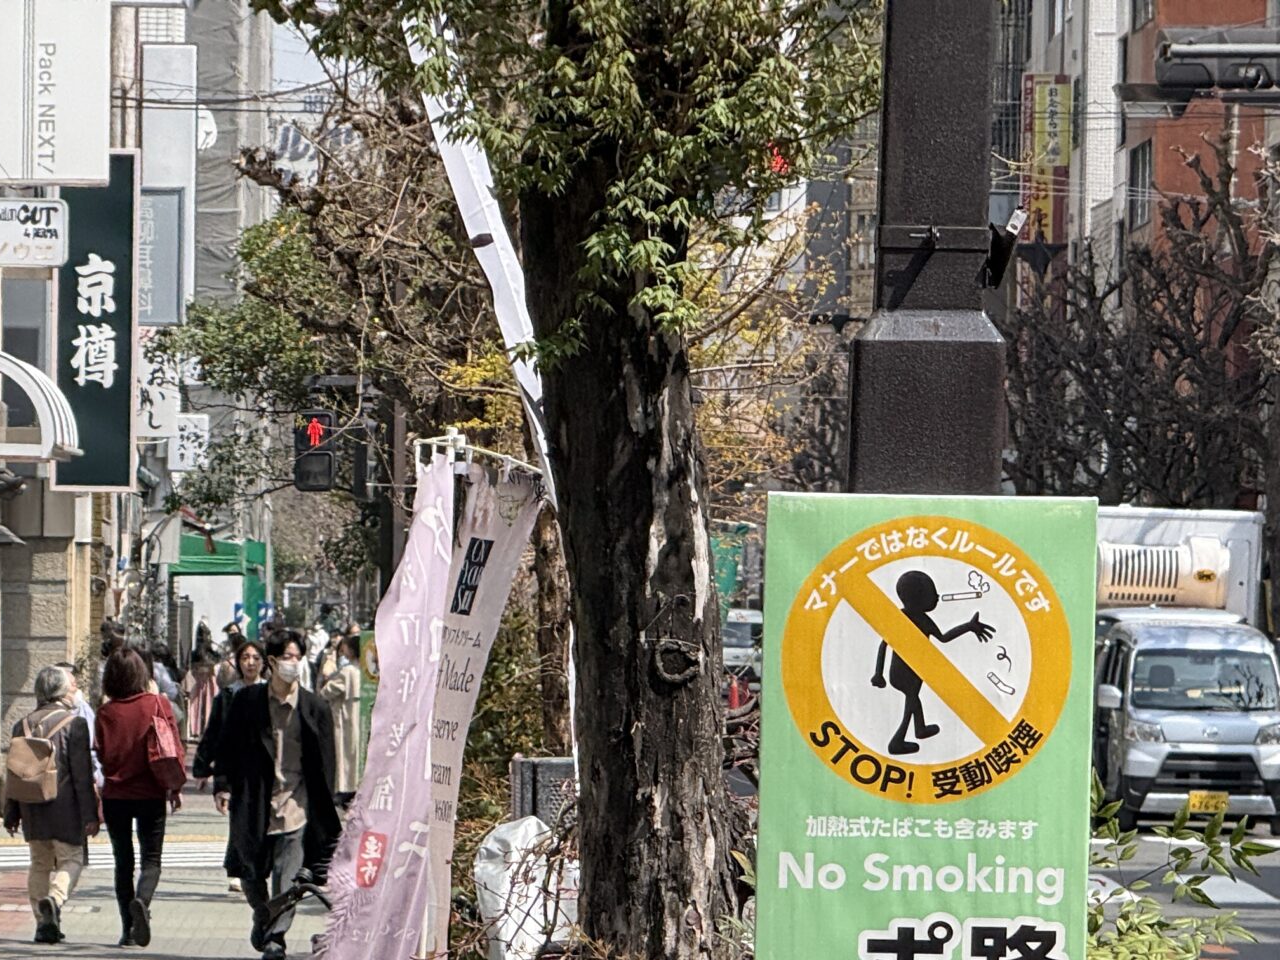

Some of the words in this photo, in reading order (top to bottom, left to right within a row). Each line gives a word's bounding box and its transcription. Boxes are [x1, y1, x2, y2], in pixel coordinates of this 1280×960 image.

[38, 42, 57, 96] Pack
[17, 204, 59, 227] CUT
[70, 253, 119, 389] 京樽
[804, 526, 1051, 613] マナーではなくルールです
[431, 763, 452, 786] ream
[809, 720, 915, 799] STOP!
[932, 718, 1043, 800] 受動喫煙
[806, 816, 1039, 841] 加熱式たばこも含みます
[778, 851, 846, 890] No
[863, 852, 1065, 905] Smoking
